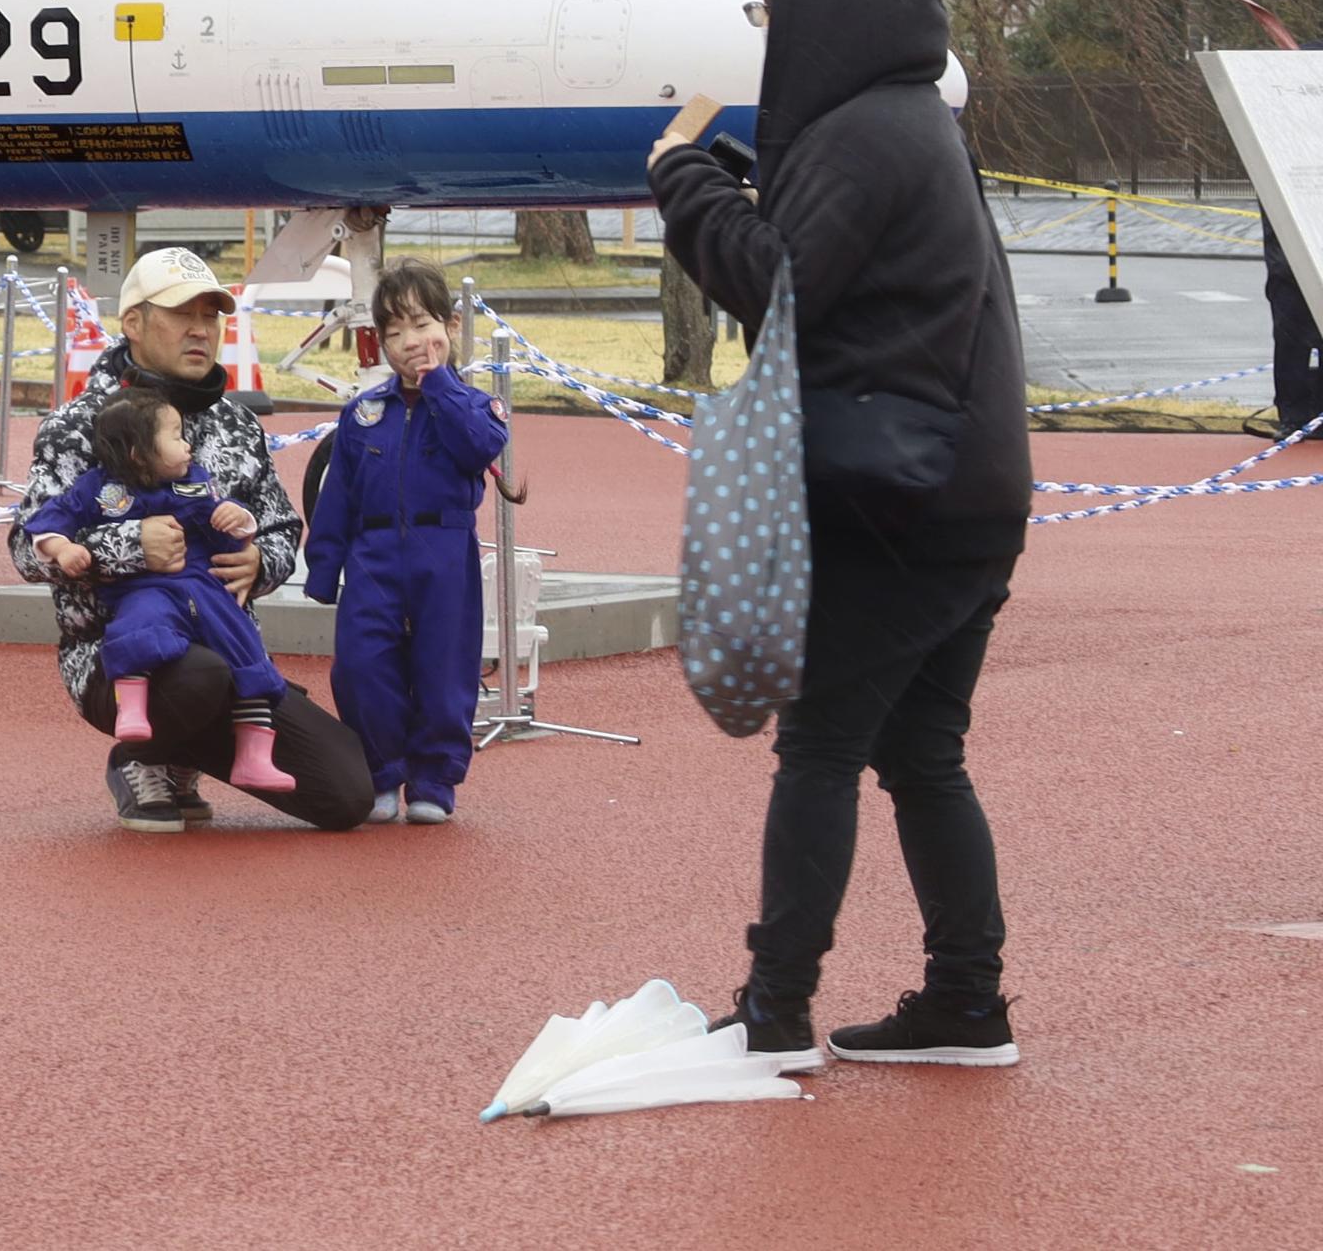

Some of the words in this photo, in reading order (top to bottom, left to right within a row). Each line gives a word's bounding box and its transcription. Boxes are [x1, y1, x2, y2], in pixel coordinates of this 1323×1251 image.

[200, 16, 215, 36] 2
[110, 227, 120, 244] DO
[98, 233, 107, 274] PAINT
[110, 250, 120, 276] NOT
